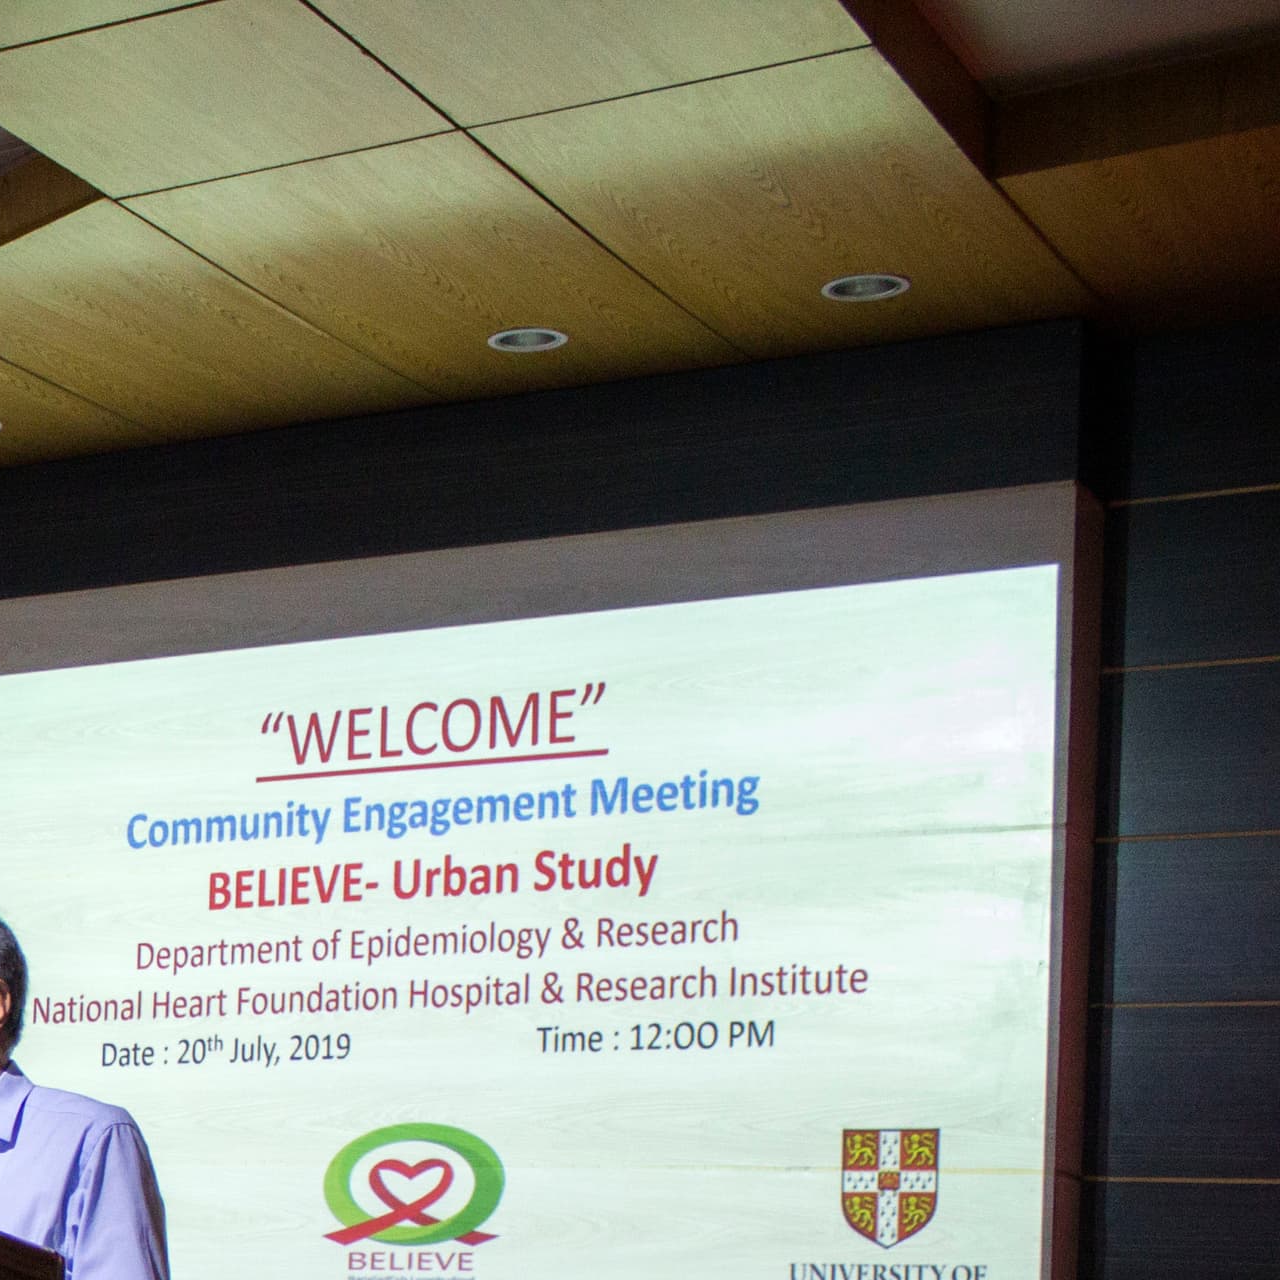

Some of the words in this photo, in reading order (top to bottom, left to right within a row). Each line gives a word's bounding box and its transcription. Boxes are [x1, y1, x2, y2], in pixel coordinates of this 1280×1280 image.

[126, 801, 332, 849] Community
[343, 783, 577, 839] Engagement
[590, 769, 760, 816] Meeting
[392, 854, 519, 900] Urban
[533, 843, 659, 897] Study
[135, 934, 303, 976] Department
[311, 929, 342, 961] of
[349, 921, 551, 966] Epidemiology
[560, 917, 585, 950] &
[596, 910, 739, 948] Research
[32, 990, 142, 1025] National
[151, 989, 227, 1019] Heart
[237, 981, 398, 1015] Foundation
[408, 973, 531, 1014] Hospital
[540, 971, 564, 1004] &
[576, 966, 717, 1002] Research
[729, 963, 869, 997] Institute
[101, 1043, 155, 1068] Date
[230, 1035, 280, 1069] July,
[289, 1033, 351, 1062] 2019
[537, 1025, 604, 1054] Time
[728, 1020, 776, 1049] PM
[348, 1252, 475, 1271] BELIEVE
